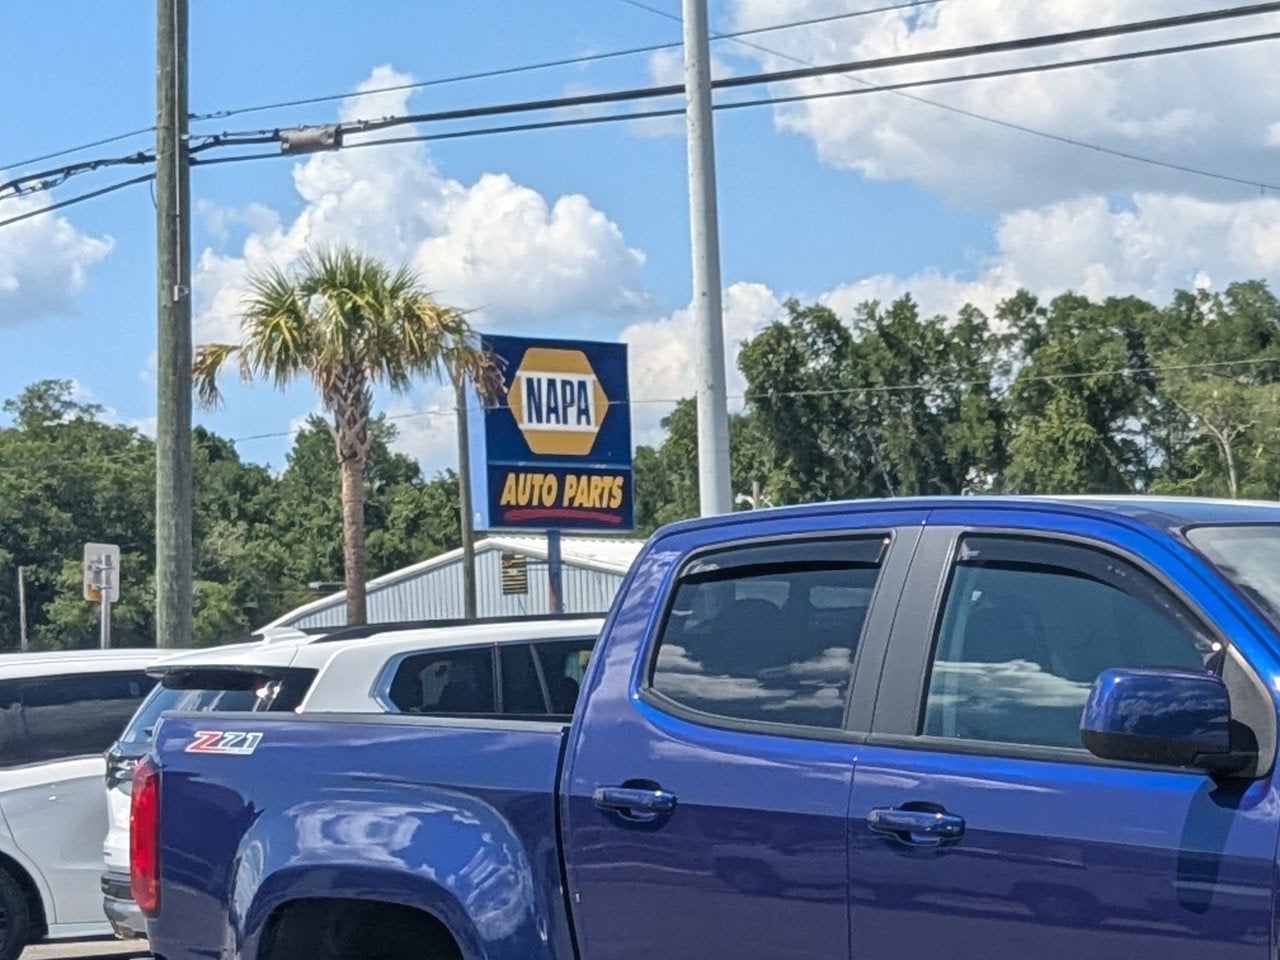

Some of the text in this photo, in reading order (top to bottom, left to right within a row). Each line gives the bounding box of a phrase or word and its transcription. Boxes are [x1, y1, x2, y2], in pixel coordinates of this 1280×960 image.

[525, 376, 592, 426] NAPA
[500, 472, 624, 509] AUTO PARTS
[185, 730, 264, 755] Z71
